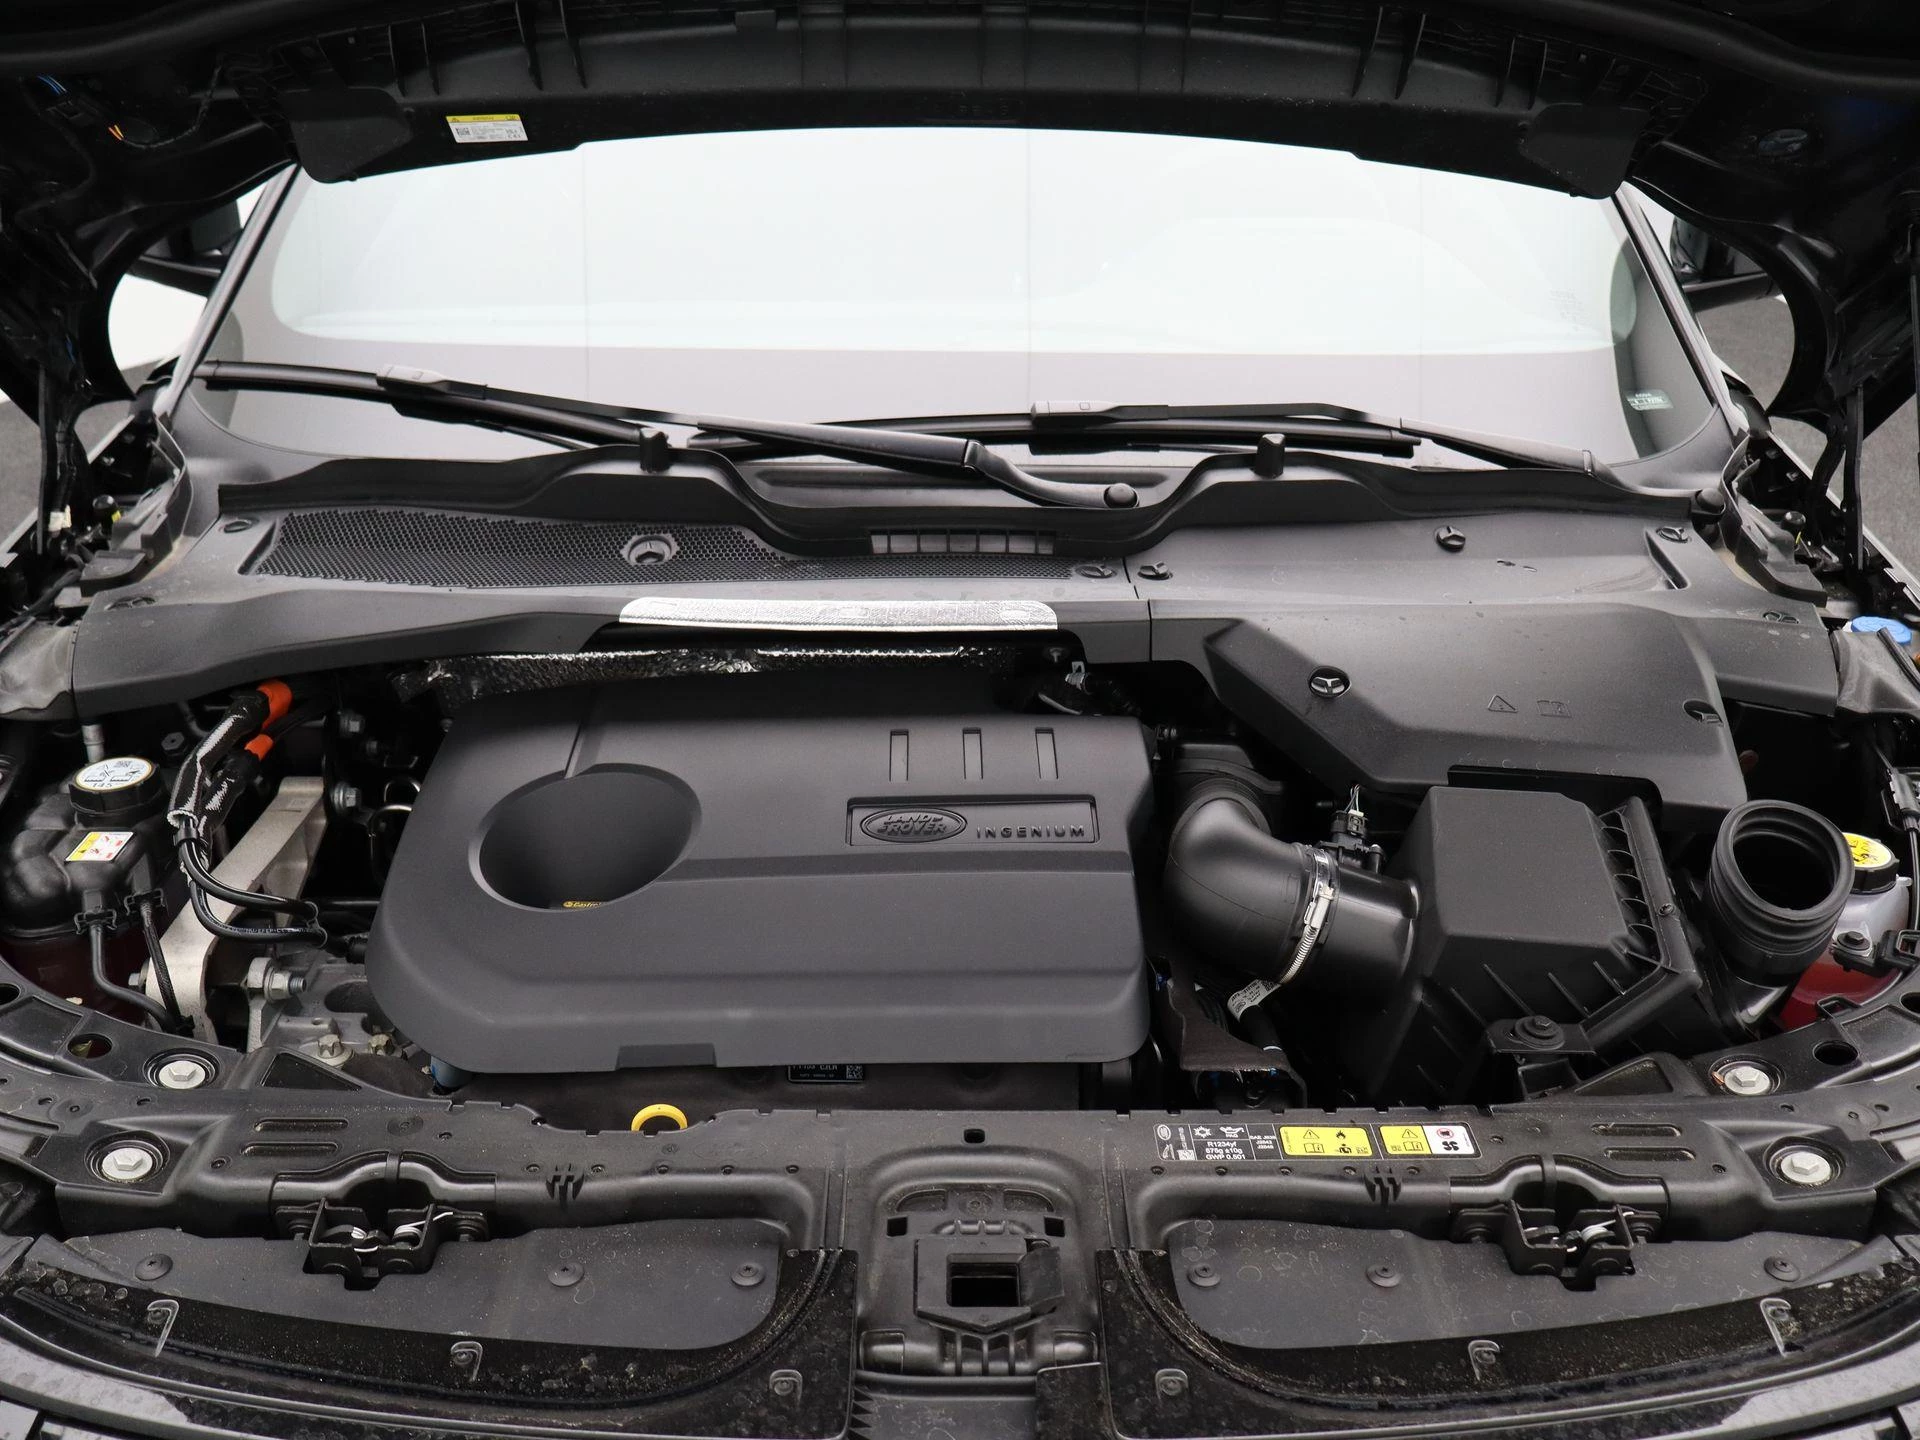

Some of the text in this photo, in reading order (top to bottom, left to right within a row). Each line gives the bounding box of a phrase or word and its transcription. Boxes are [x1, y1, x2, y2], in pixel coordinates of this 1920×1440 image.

[884, 815, 931, 825] LAND
[885, 821, 947, 836] ROVER
[976, 825, 1085, 839] INGENIUM
